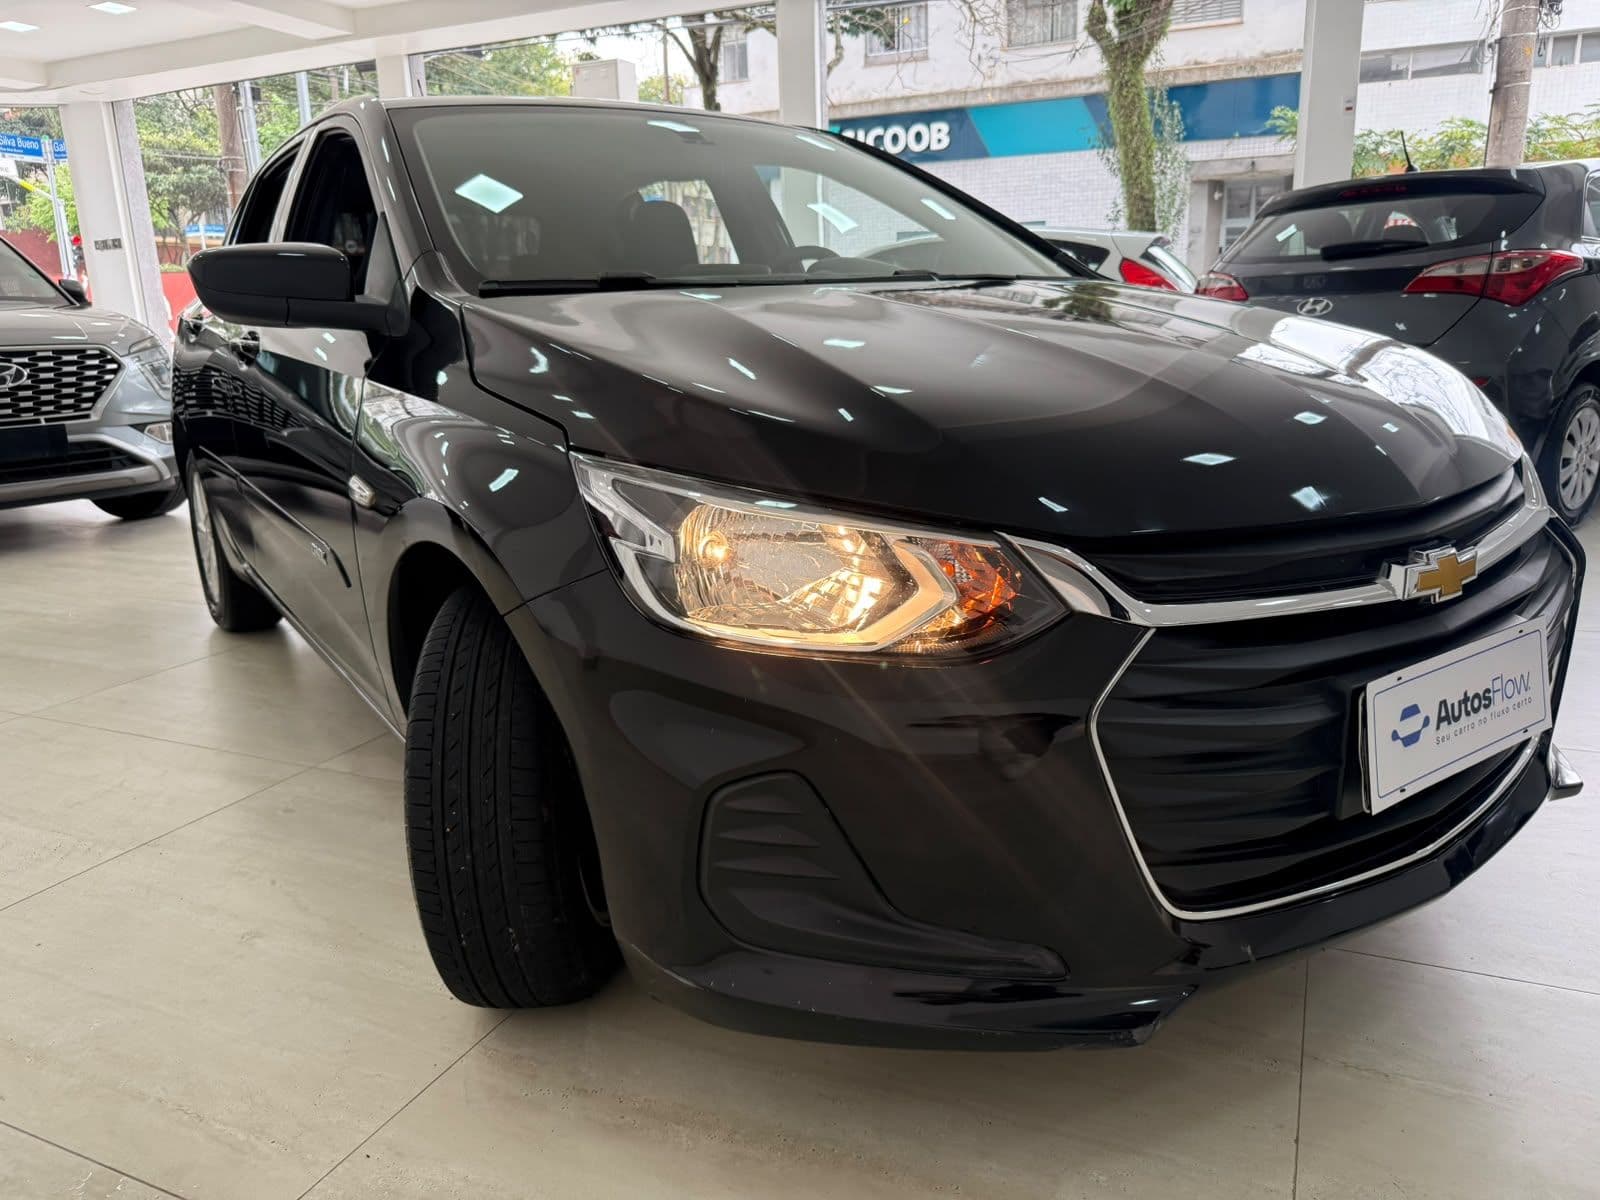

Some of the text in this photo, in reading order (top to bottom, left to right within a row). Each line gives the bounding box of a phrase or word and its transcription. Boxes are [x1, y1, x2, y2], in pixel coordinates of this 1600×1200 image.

[17, 137, 39, 150] Bueno
[1435, 696, 1533, 745] Seu carro no fluxo certo
